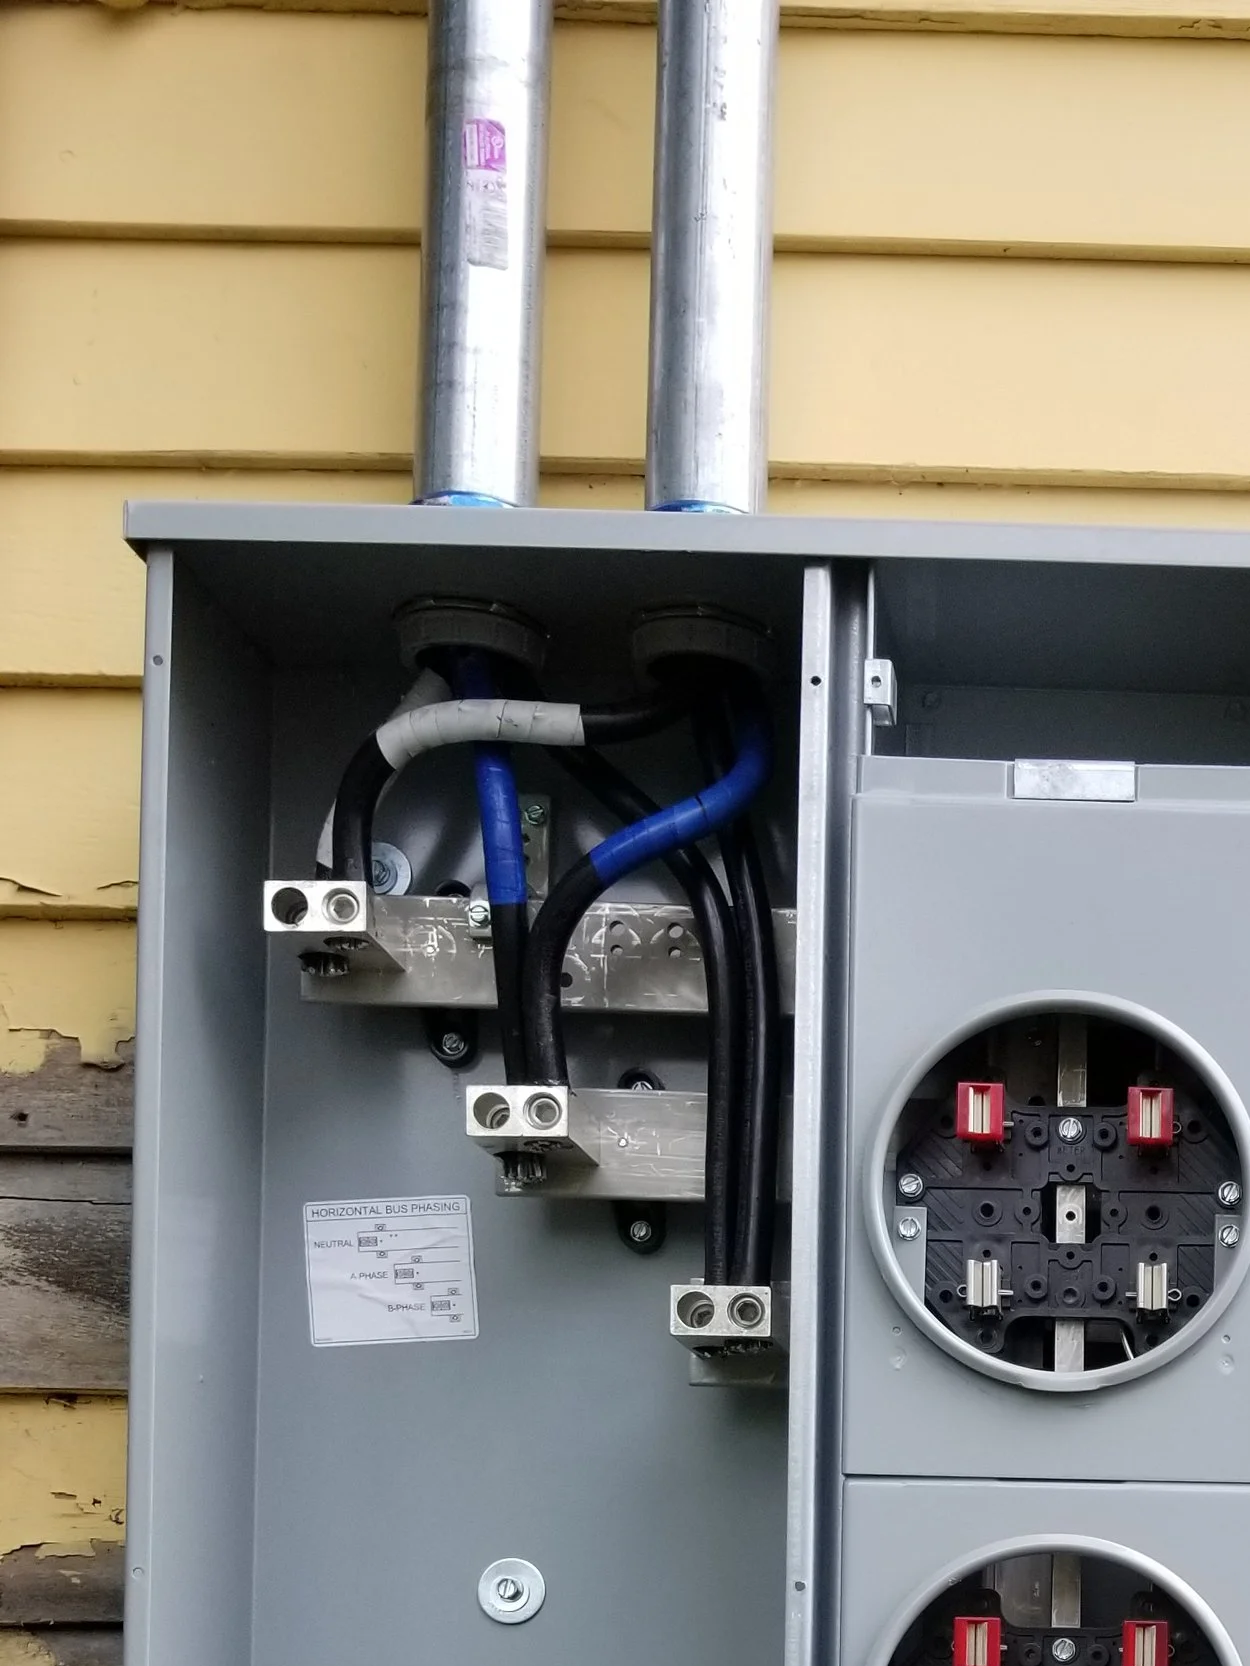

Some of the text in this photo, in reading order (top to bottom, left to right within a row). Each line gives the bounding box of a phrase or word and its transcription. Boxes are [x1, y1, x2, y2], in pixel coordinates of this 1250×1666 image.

[312, 1202, 460, 1218] HORIZONTAL BUS PHASING
[314, 1240, 354, 1248] NEUTRAL
